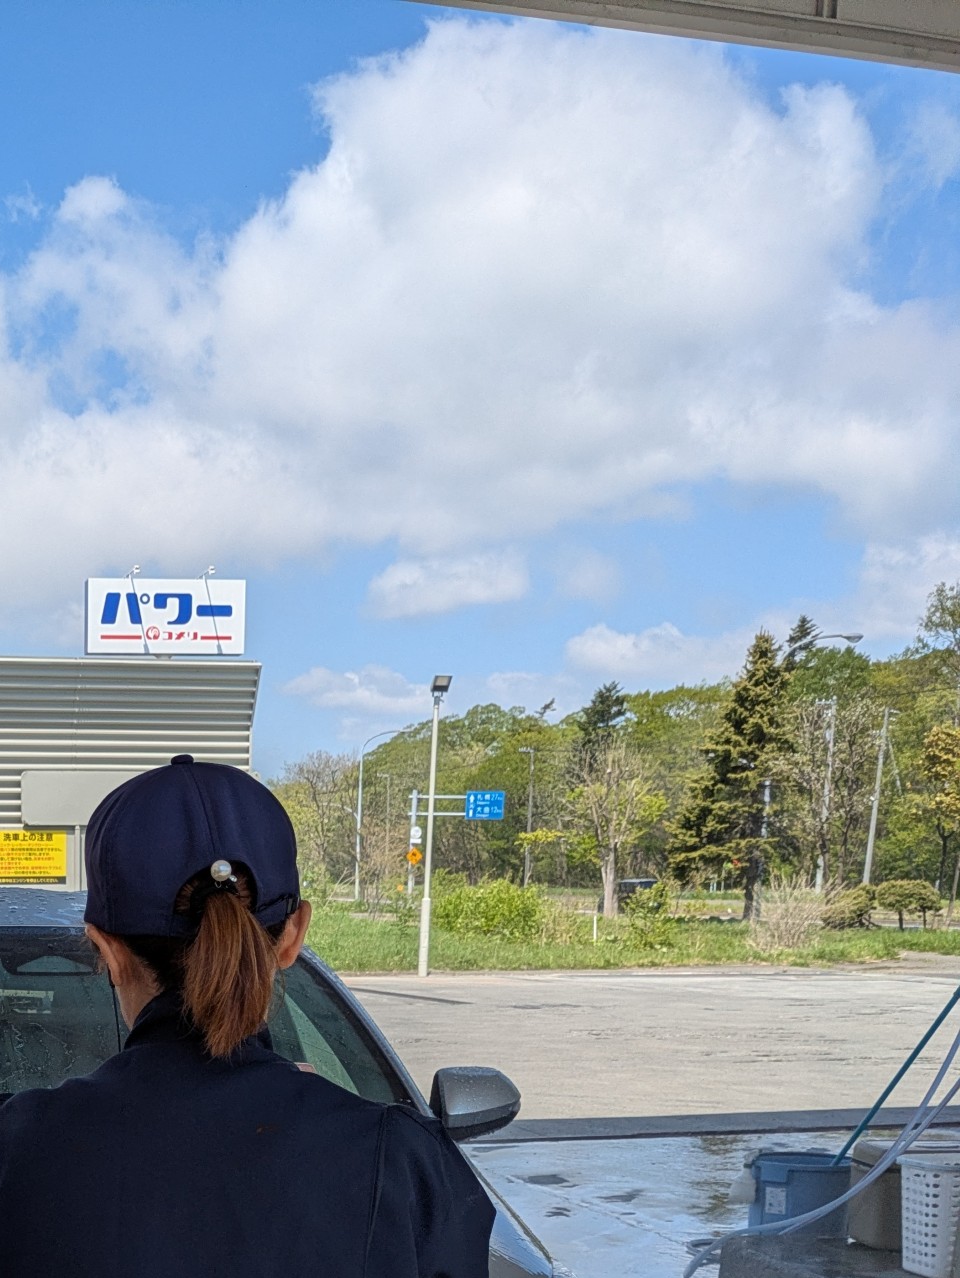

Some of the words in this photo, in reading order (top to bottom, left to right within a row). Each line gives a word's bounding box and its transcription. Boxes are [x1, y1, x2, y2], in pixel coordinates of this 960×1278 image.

[100, 592, 233, 625] パワー
[162, 631, 199, 641] コメリ
[3, 833, 54, 842] 洗車上の注意
